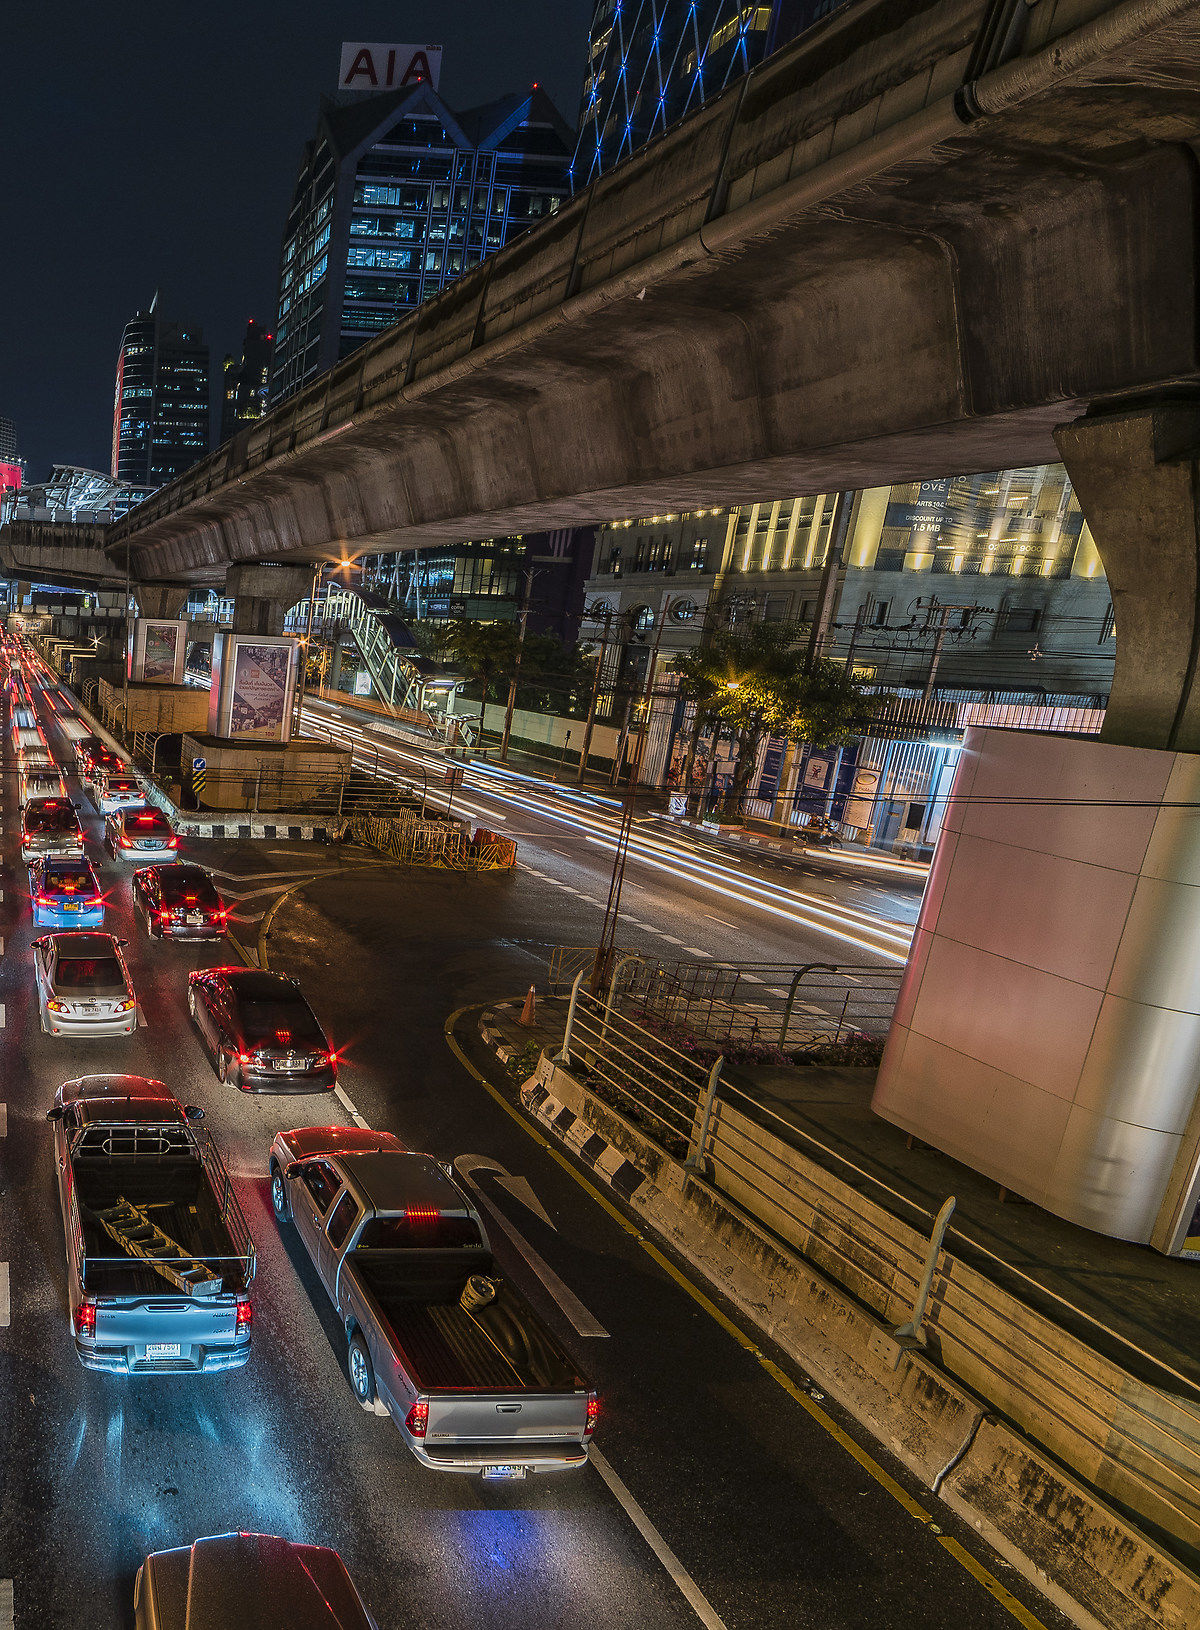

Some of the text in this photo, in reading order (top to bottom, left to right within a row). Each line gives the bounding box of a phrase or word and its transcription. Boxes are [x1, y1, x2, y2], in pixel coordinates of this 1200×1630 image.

[344, 48, 434, 88] AIA
[912, 482, 946, 493] MOVE
[905, 515, 935, 523] DISCOUNT
[912, 523, 941, 532] 1.5 MB
